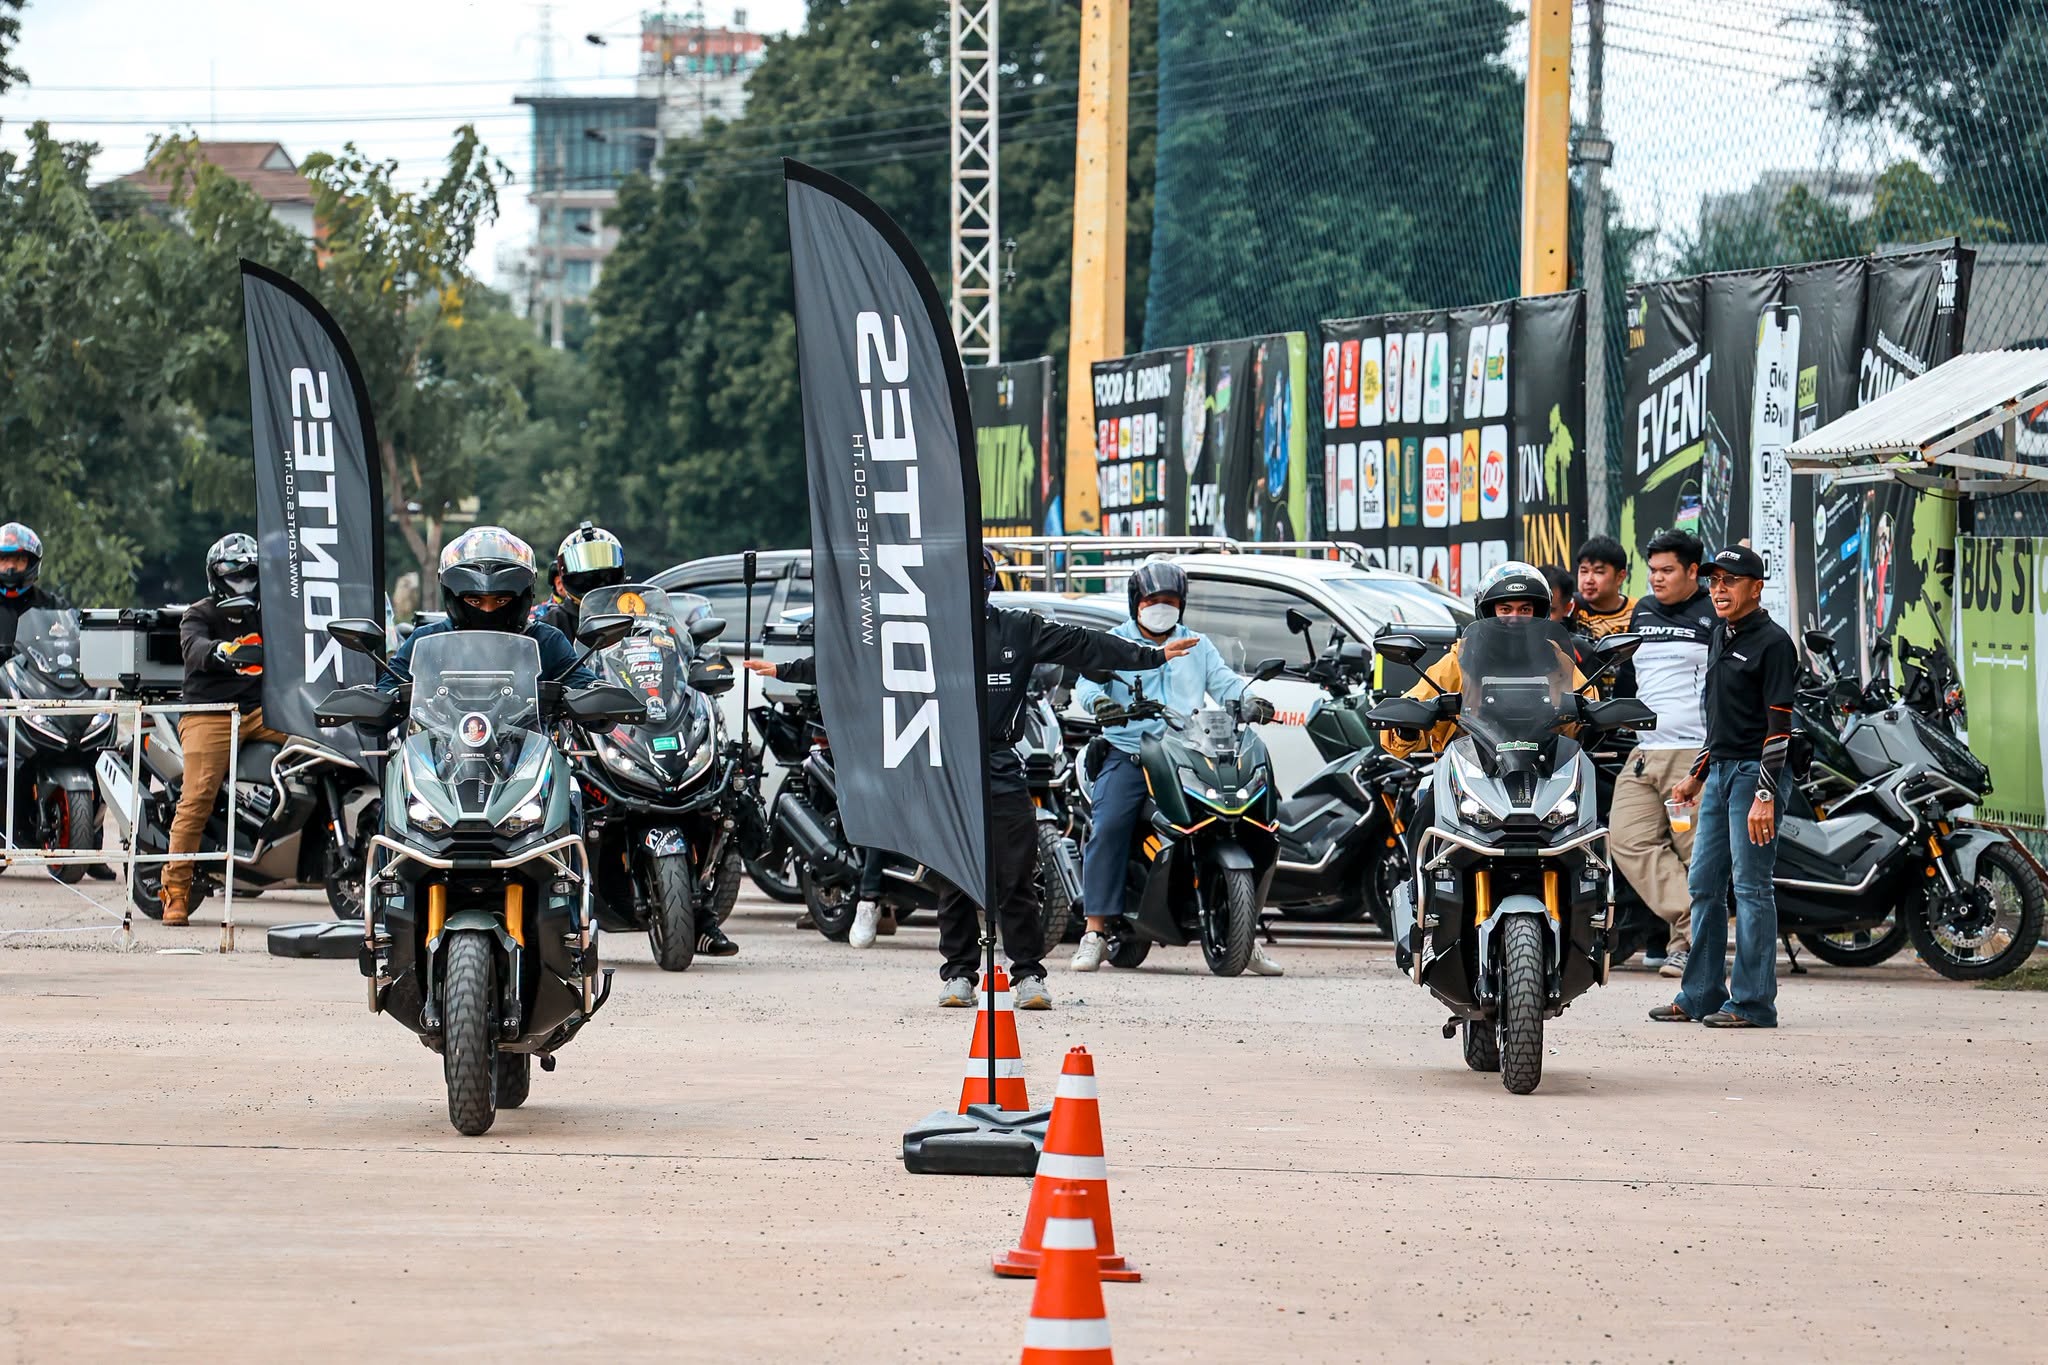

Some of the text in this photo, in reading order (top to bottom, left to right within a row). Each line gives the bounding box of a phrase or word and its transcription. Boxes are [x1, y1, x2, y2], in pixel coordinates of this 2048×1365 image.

[1094, 372, 1124, 408] FOOD
[1124, 370, 1135, 404] &
[1636, 353, 1712, 476] EVENT
[1426, 482, 1445, 502] KING
[1518, 443, 1544, 503] TON
[1522, 511, 1571, 573] TANN
[1961, 537, 2004, 612] BUS
[1638, 626, 1696, 638] ZONTES
